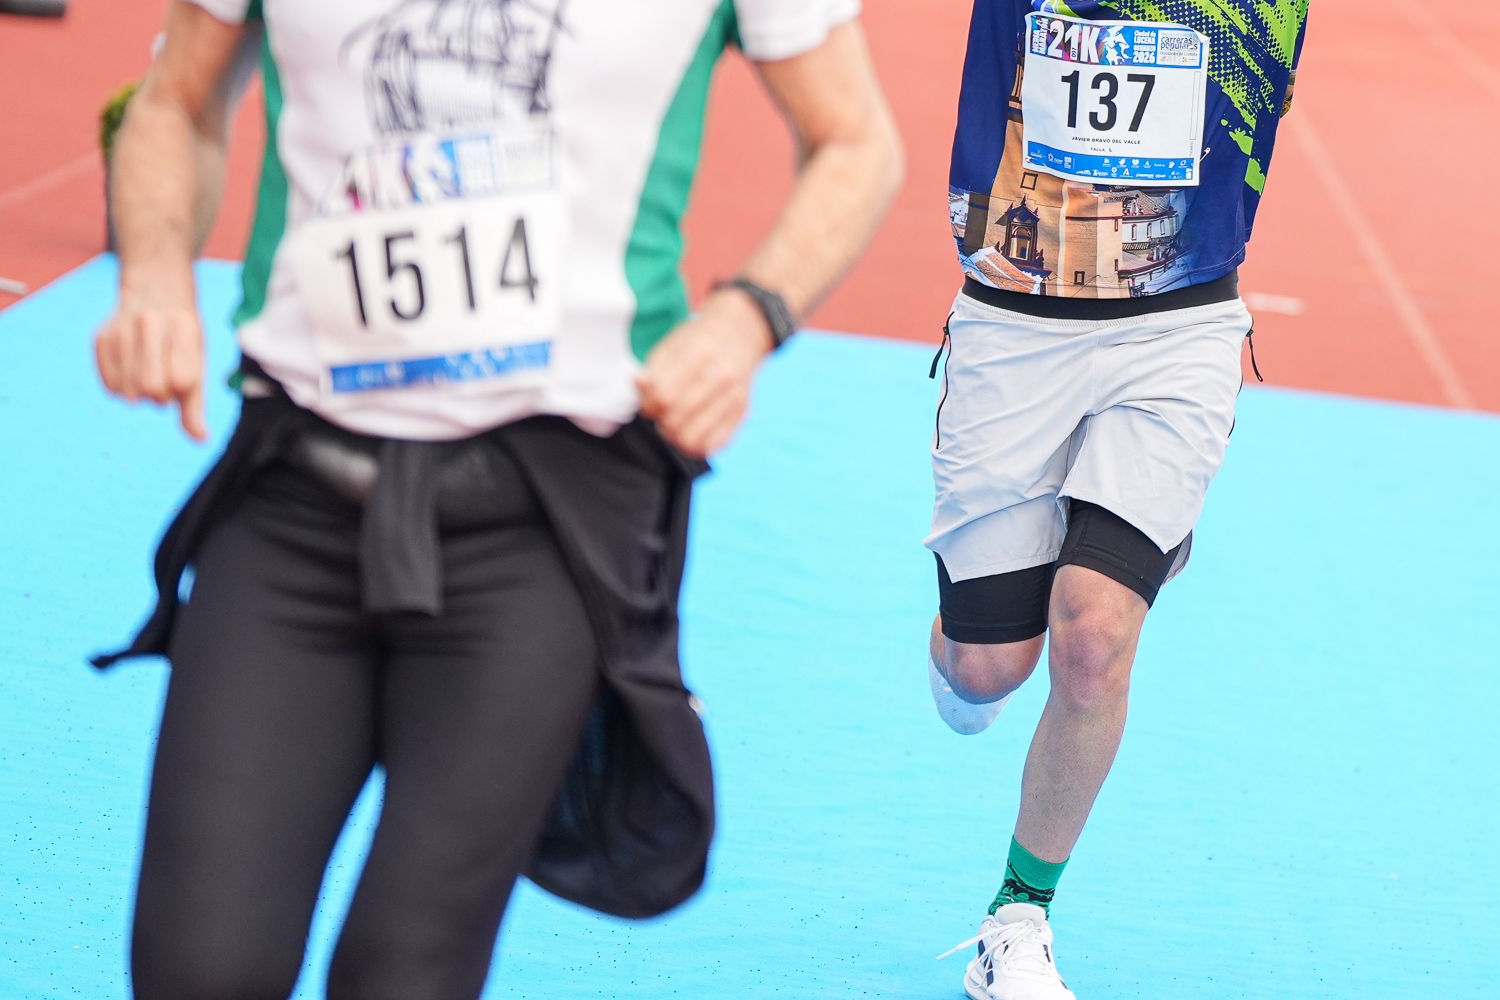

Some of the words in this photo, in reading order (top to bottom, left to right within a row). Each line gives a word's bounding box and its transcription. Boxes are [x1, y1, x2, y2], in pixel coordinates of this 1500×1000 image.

[1048, 20, 1101, 63] 21K
[1133, 51, 1156, 63] 2026
[1161, 36, 1193, 44] carreras
[1061, 70, 1156, 132] 137
[334, 215, 540, 329] 1514
